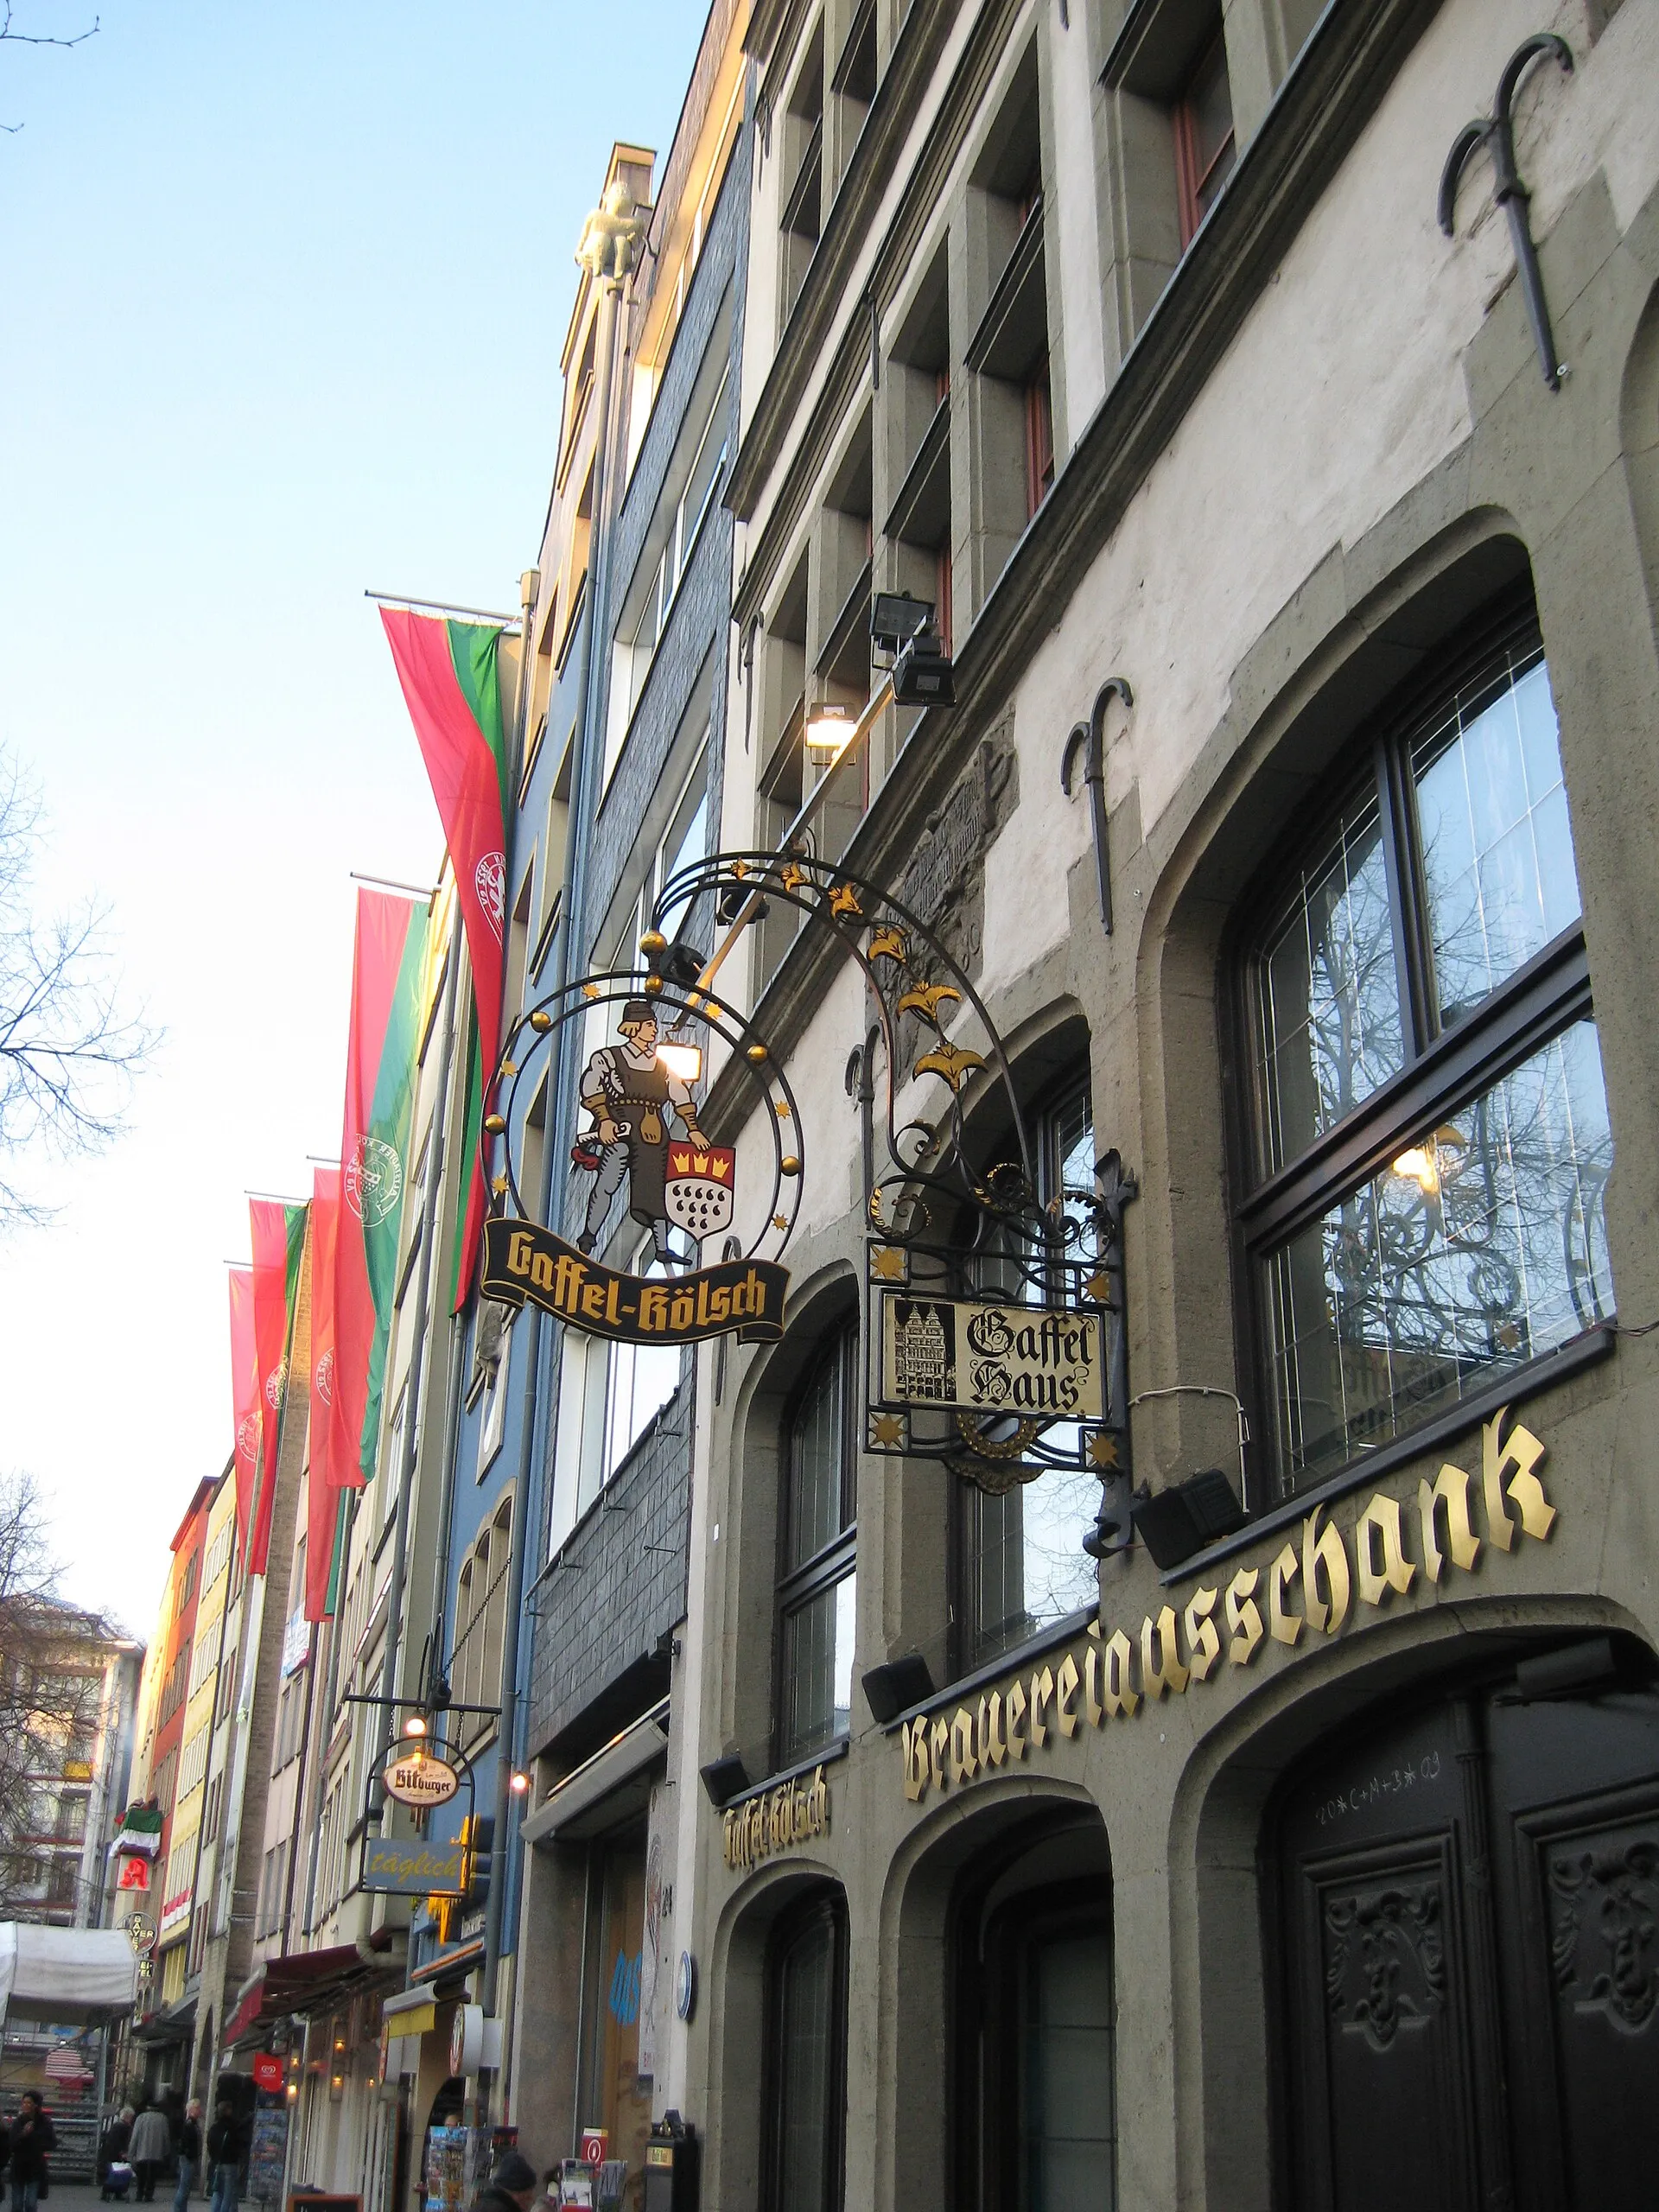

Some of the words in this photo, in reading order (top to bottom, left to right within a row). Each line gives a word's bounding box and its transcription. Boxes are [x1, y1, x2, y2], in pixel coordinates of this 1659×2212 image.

[506, 1230, 767, 1332] Gaffel-Kölsch
[966, 1306, 1096, 1370] Gaffel
[969, 1359, 1090, 1411] Haus
[901, 1405, 1556, 1802] Brauereiausschank
[394, 1769, 451, 1794] Bitburger
[722, 1791, 769, 1872] Gaffel
[769, 1764, 827, 1848] Kölsch
[370, 1850, 460, 1885] täglich
[127, 1929, 154, 1939] AYER
[132, 1915, 142, 1951] BAYER
